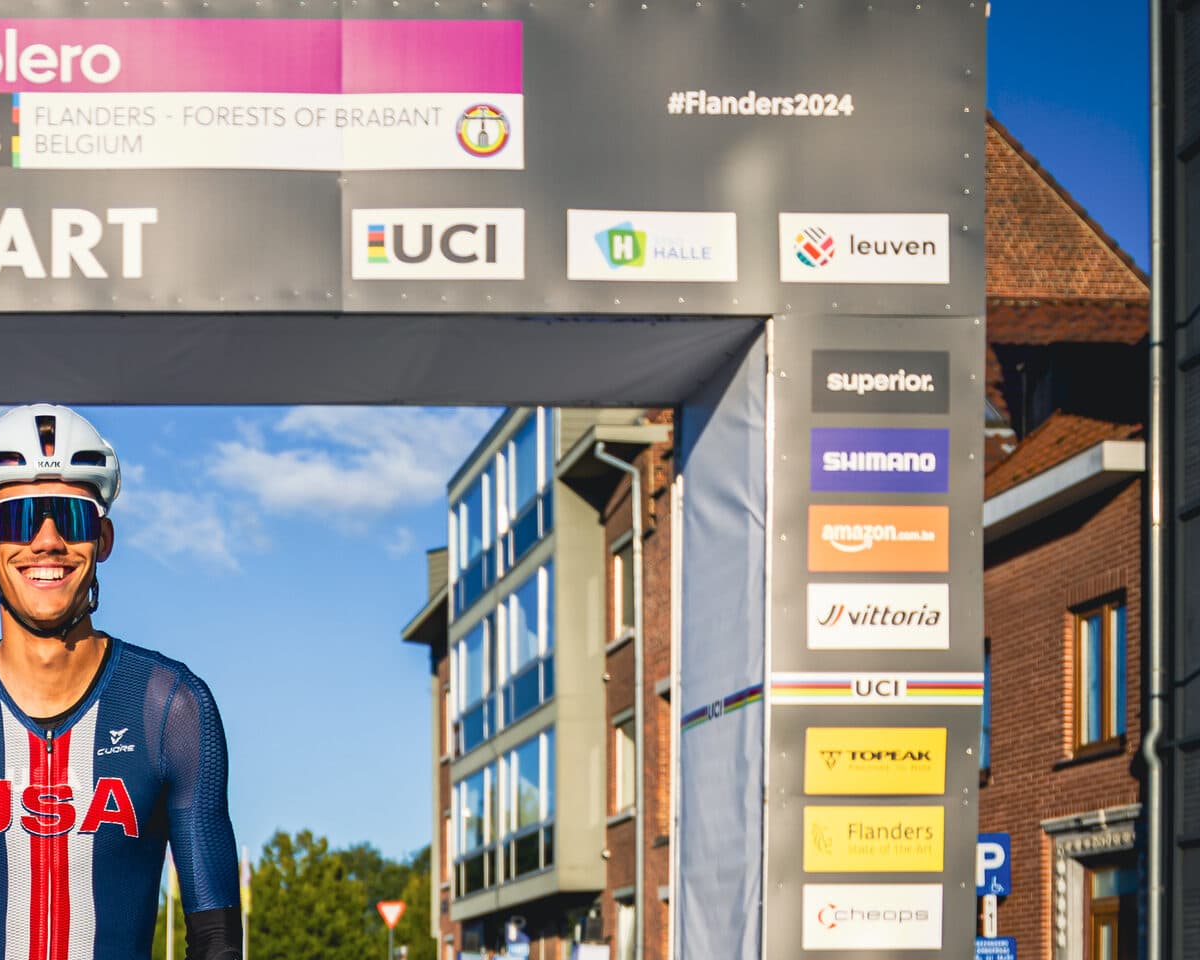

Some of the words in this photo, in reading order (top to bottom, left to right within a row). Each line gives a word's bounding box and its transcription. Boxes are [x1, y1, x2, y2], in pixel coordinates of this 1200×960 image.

[667, 91, 854, 117] #Flanders2024
[34, 106, 157, 128] FLANDERS
[182, 106, 286, 128] FORESTS
[295, 106, 331, 128] OF
[335, 106, 442, 129] BRABANT
[34, 134, 144, 154] BELGIUM
[392, 223, 497, 264] UCI
[654, 246, 712, 260] HALLE
[849, 235, 937, 257] leuven
[826, 369, 934, 395] superior.
[823, 452, 936, 472] SHIMANO
[848, 604, 941, 627] vittoria
[855, 679, 900, 698] UCI
[847, 750, 932, 761] TOPEAK
[848, 822, 934, 840] Flanders
[976, 842, 1006, 888] P
